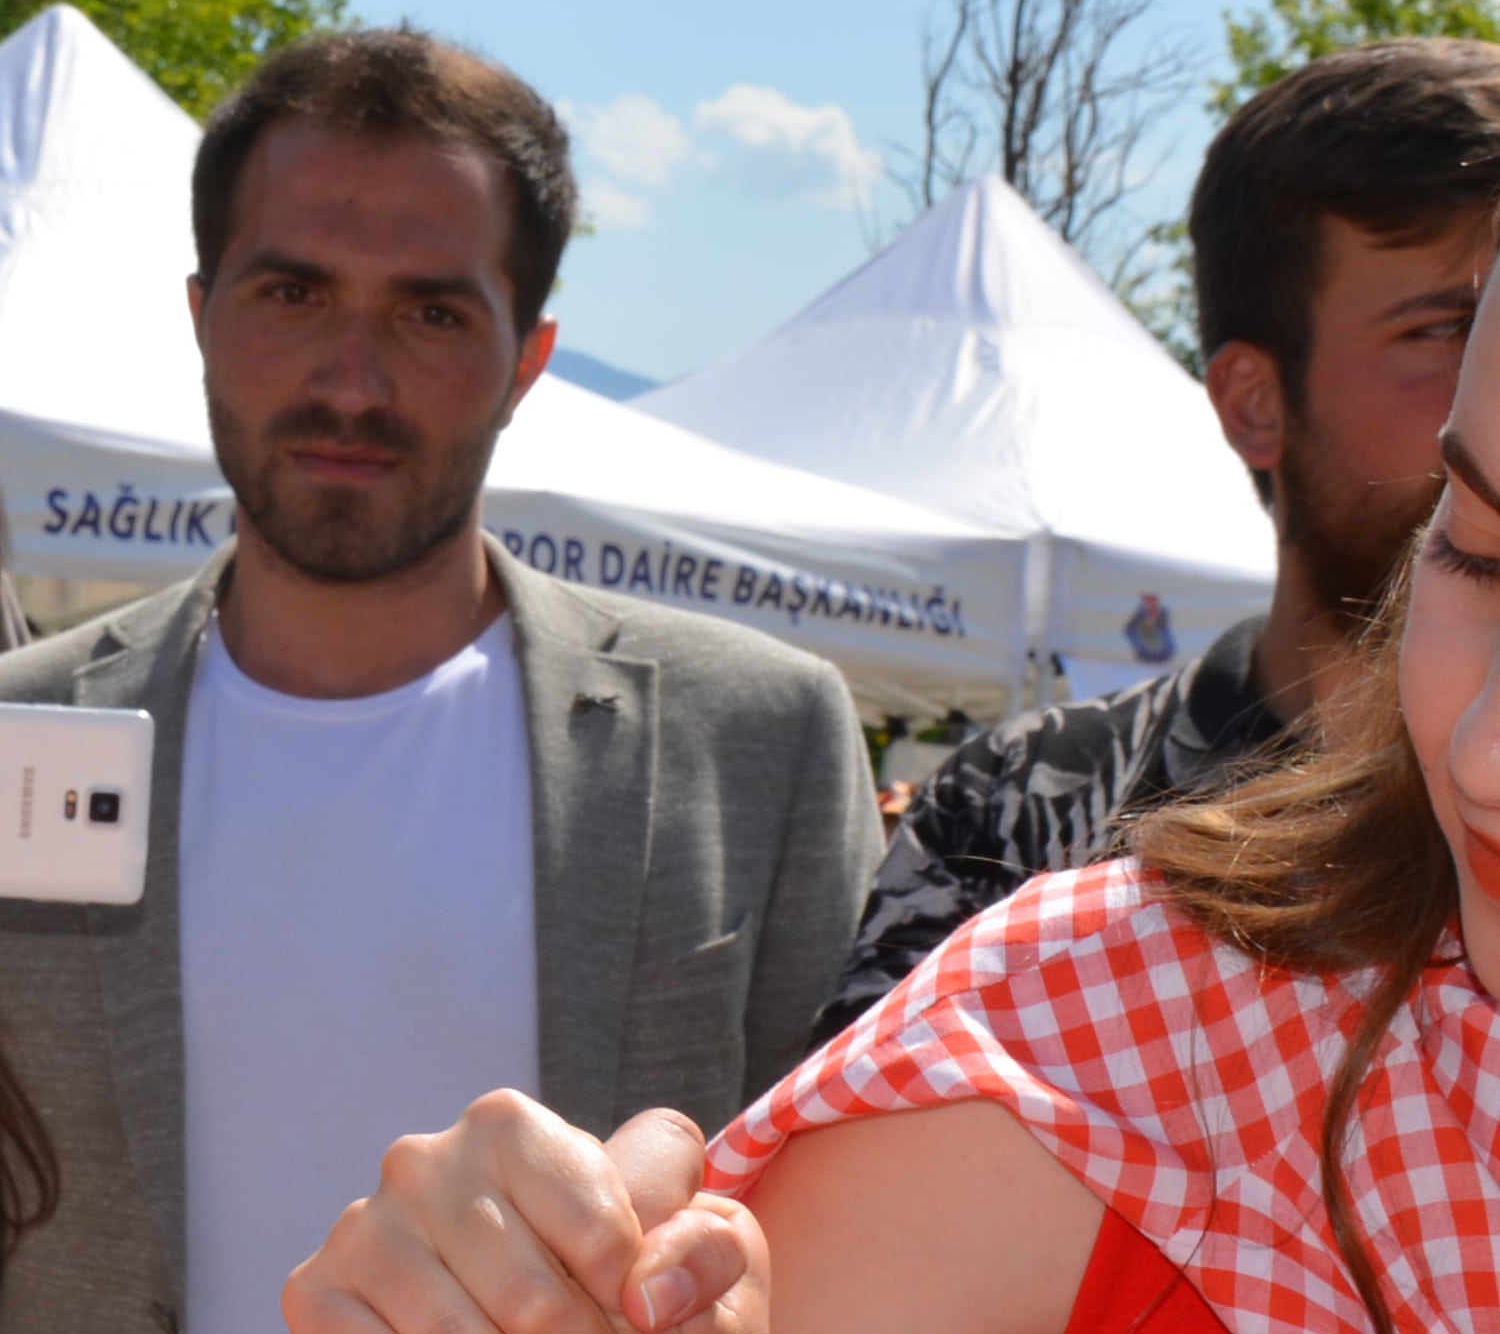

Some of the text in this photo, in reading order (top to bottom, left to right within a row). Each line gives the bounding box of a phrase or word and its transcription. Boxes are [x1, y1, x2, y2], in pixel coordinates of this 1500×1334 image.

[43, 482, 216, 549] SAĞLIK
[497, 527, 587, 584] POR
[600, 540, 723, 602] DAİRE
